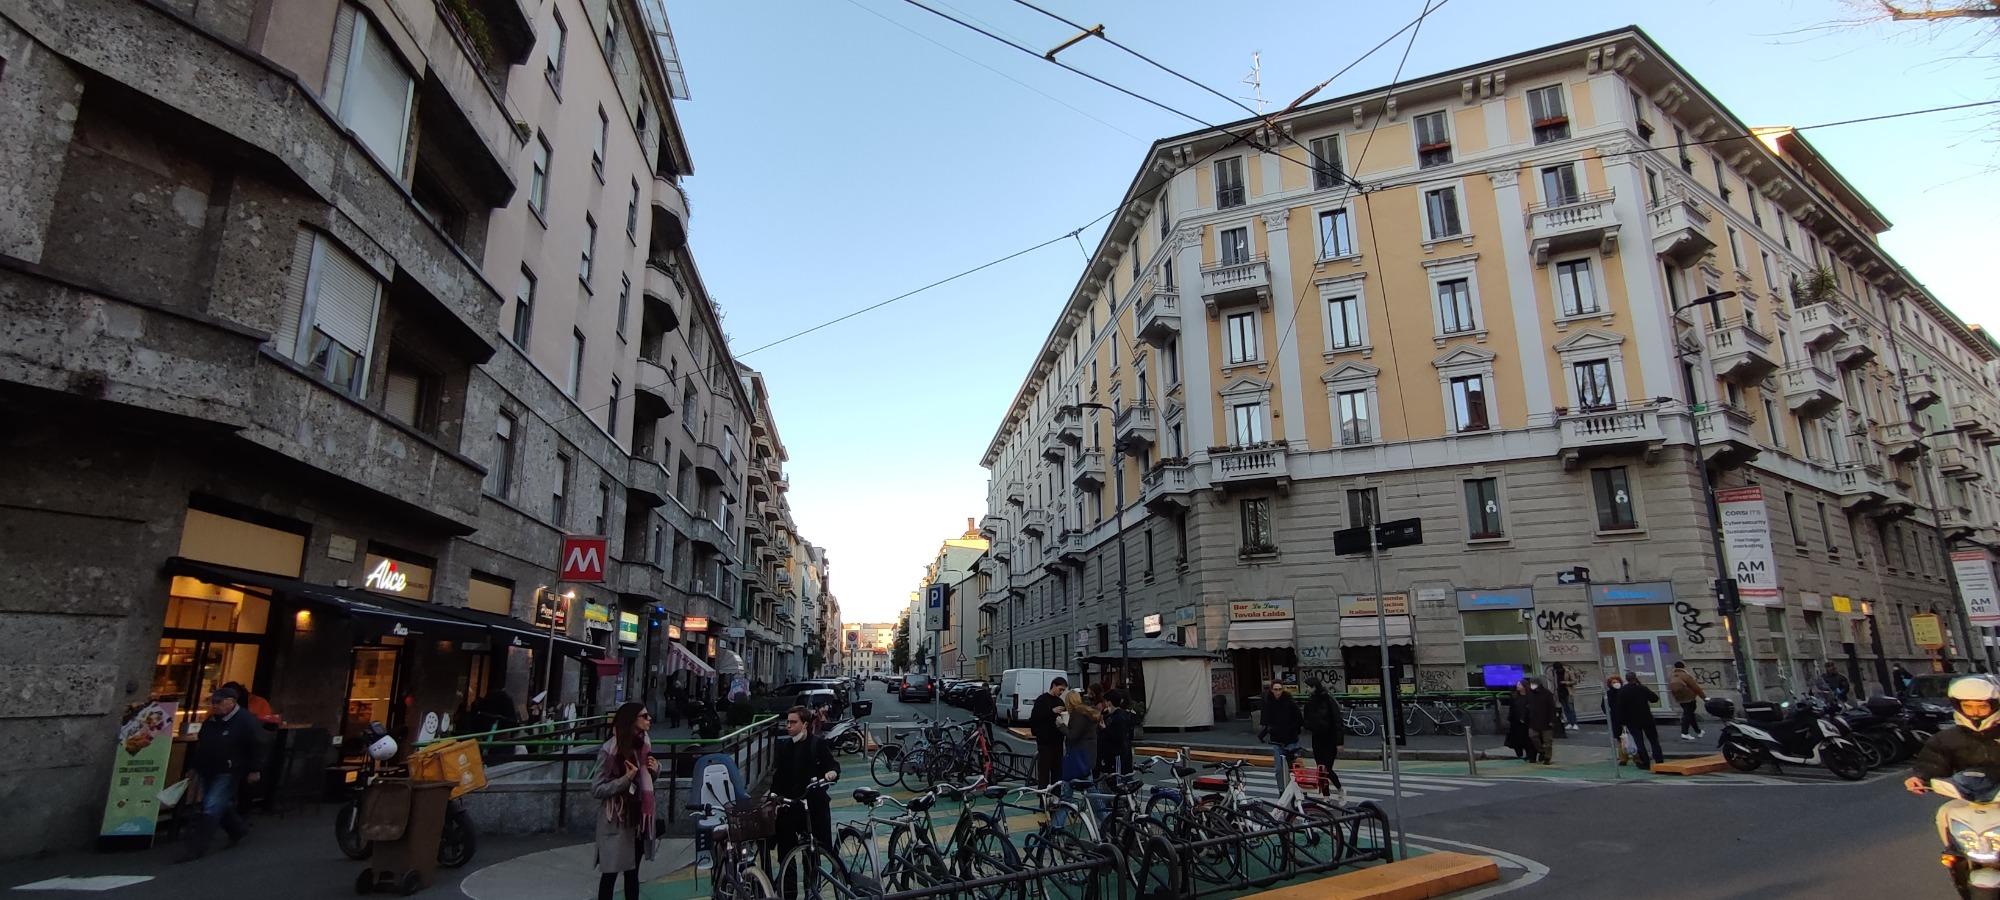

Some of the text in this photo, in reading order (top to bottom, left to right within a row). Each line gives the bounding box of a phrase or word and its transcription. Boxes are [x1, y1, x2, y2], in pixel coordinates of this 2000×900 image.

[565, 547, 600, 572] M
[1737, 561, 1765, 572] AM
[365, 560, 406, 591] Alice
[1738, 573, 1756, 584] MI
[931, 590, 938, 606] P
